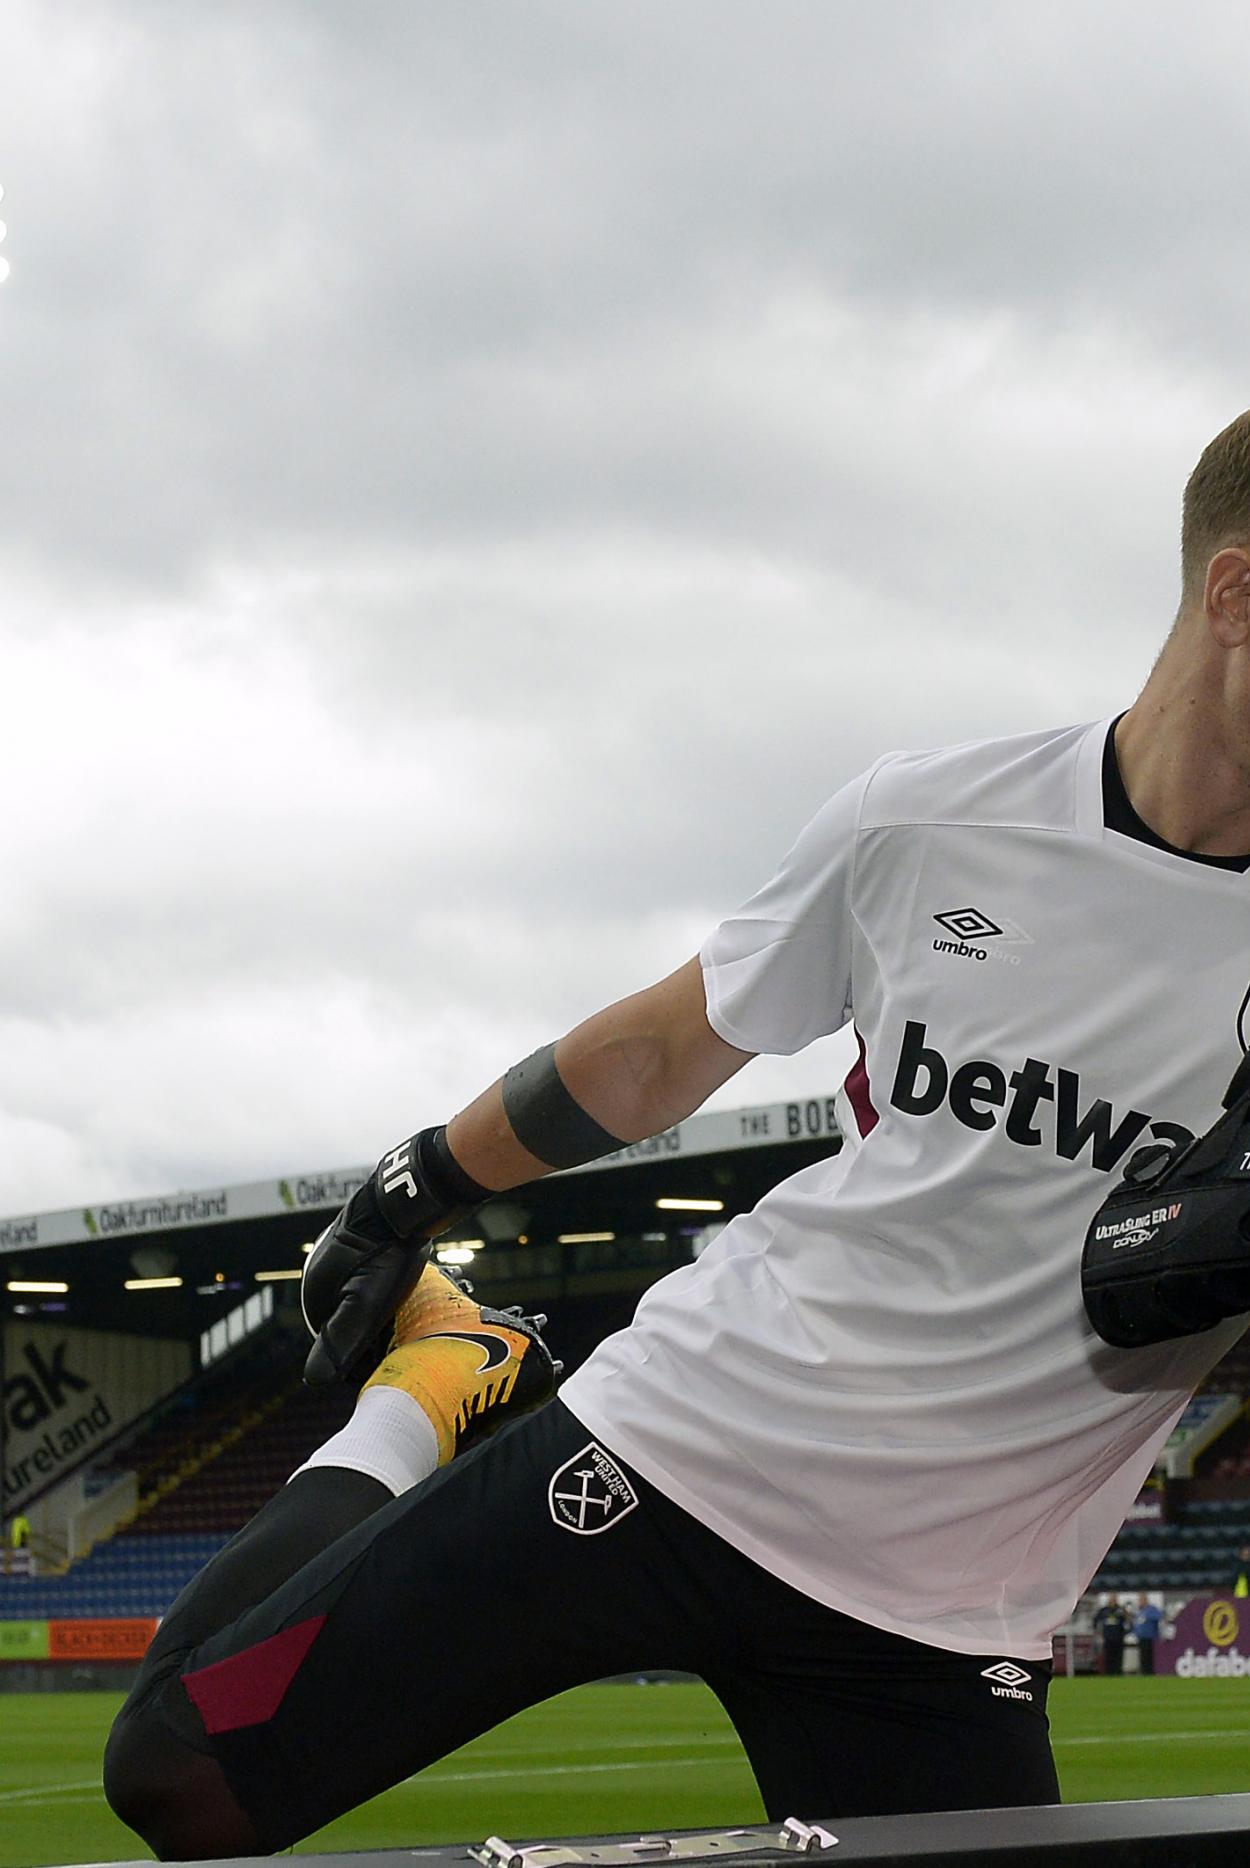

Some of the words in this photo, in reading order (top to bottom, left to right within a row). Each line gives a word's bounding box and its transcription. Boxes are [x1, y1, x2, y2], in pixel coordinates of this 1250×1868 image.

[932, 939, 988, 961] umbro
[382, 1140, 418, 1199] JH
[1167, 1203, 1182, 1220] IV
[0, 1337, 91, 1446] ak
[591, 1451, 617, 1481] WEST
[614, 1475, 632, 1504] HAM
[594, 1465, 619, 1496] UNITED
[991, 1686, 1033, 1702] umbro
